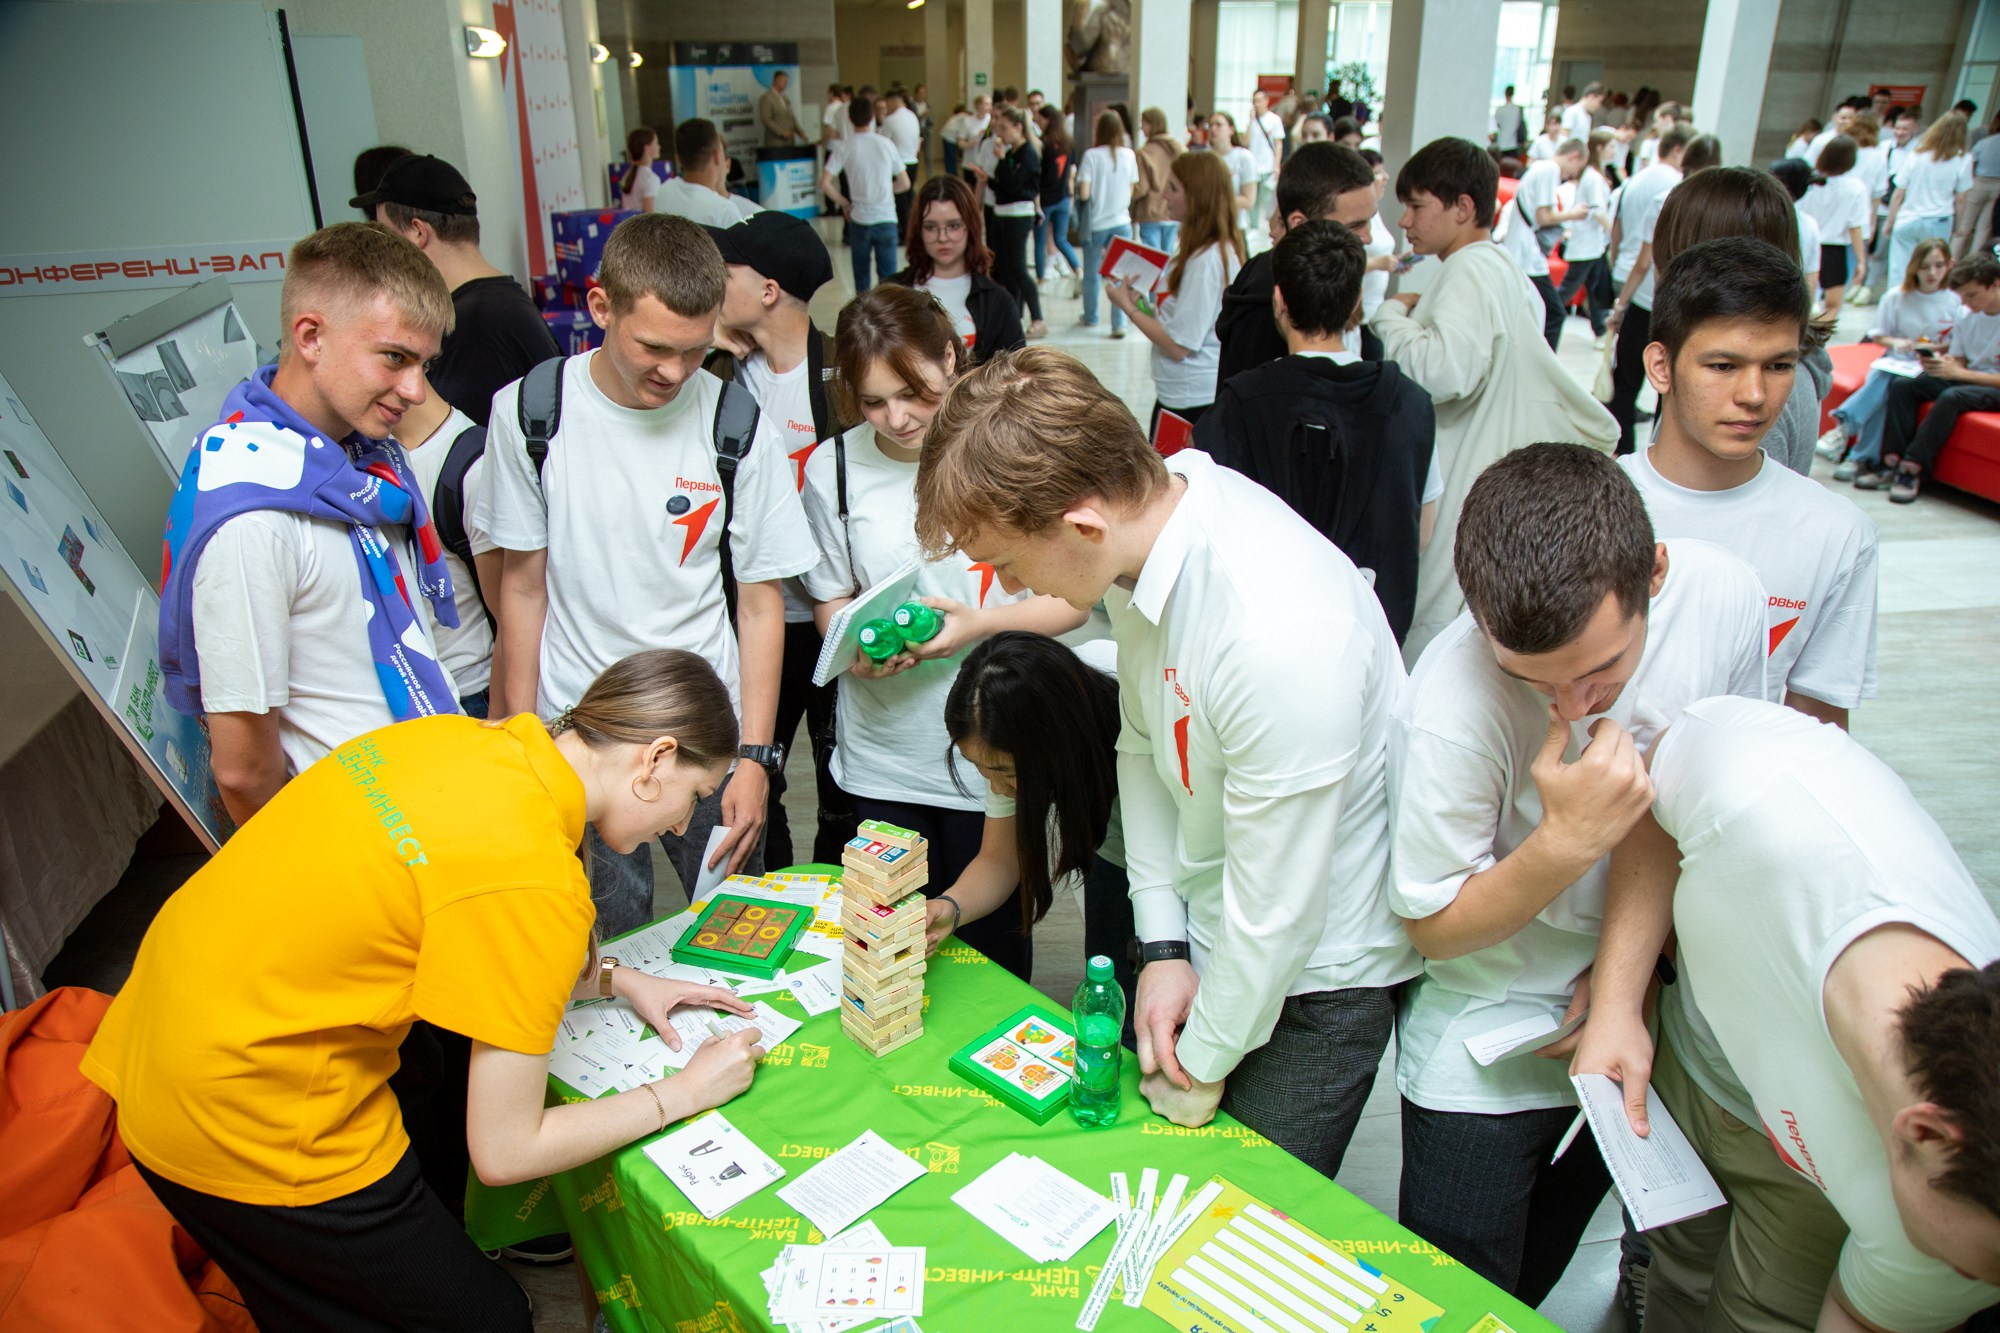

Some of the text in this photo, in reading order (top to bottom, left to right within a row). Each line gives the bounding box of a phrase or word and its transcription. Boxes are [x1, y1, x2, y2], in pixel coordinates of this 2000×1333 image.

[0, 251, 286, 286] ОНФЕРЕНЦ-ЗАЛ
[786, 419, 817, 434] Первы
[675, 477, 722, 493] Первые
[1768, 595, 1807, 610] рвые
[390, 655, 407, 680] детей
[407, 685, 428, 718] молодёж
[393, 643, 438, 717] Российское движе
[358, 737, 389, 769] БАНК
[336, 746, 429, 867] ЦЕНТР-ИНВЕСТ
[953, 956, 989, 965] БАНК
[761, 1055, 792, 1066] БАН
[1241, 1137, 1273, 1148] АНК
[1780, 1109, 1828, 1192] Первые
[678, 1163, 699, 1186] Ребус
[749, 1228, 797, 1243] БАНК
[1030, 1282, 1080, 1298] БАНК
[1156, 1281, 1181, 1299] порядку
[1393, 1293, 1405, 1303] 6
[1078, 1298, 1096, 1326] Получение
[1376, 1307, 1393, 1318] 5
[1364, 1322, 1378, 1332] 4
